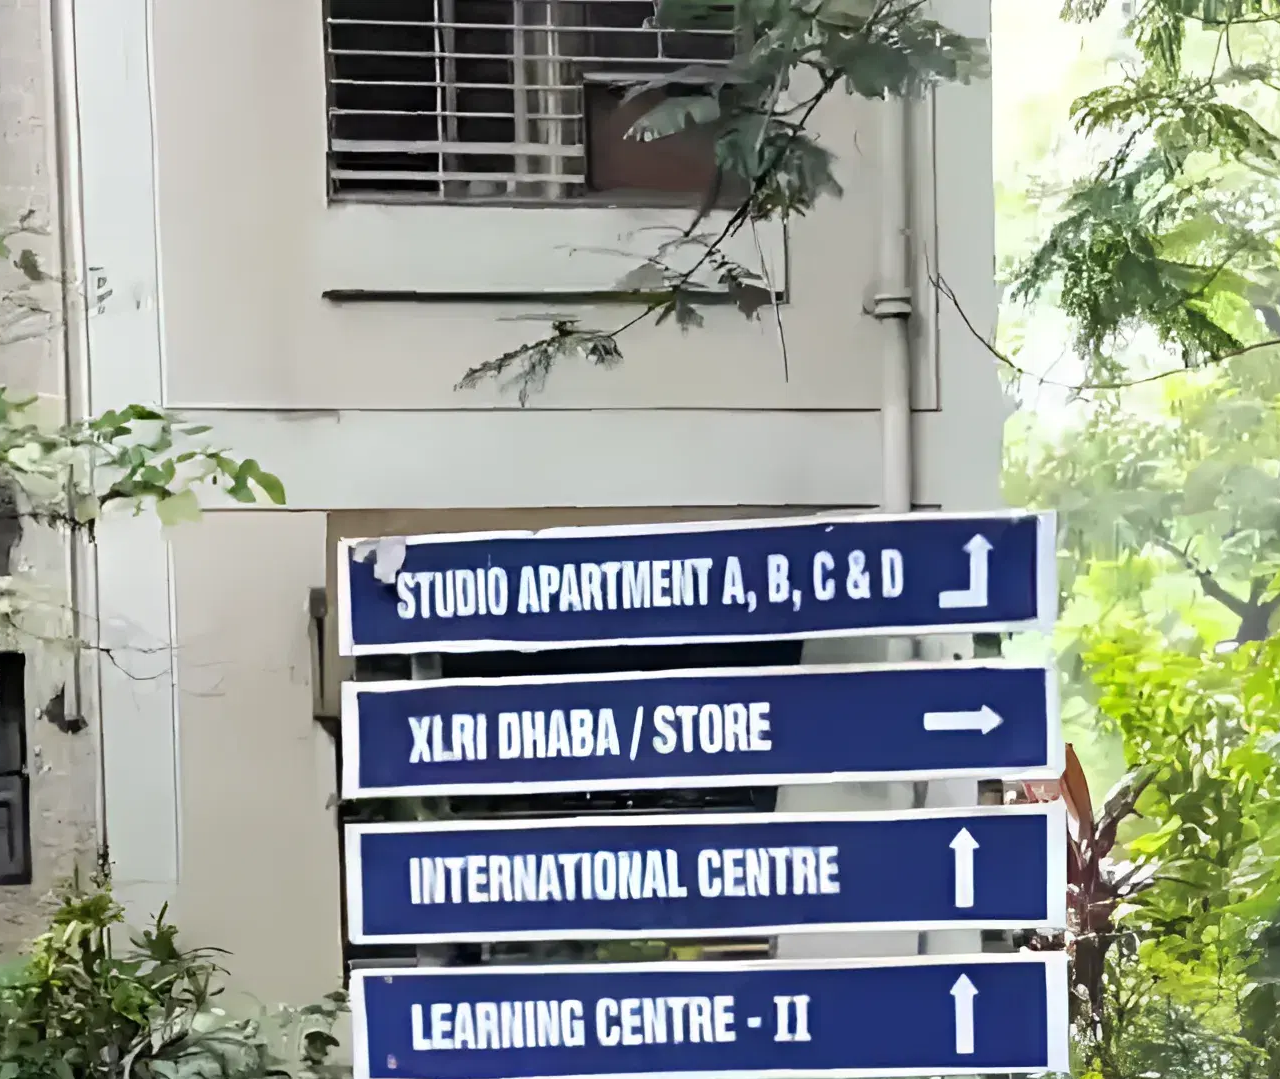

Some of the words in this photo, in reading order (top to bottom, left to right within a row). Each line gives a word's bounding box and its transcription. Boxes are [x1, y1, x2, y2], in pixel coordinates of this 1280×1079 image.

[396, 566, 509, 620] STUDIO
[517, 557, 713, 614] APARTMENT
[721, 555, 757, 613] A,
[767, 553, 802, 612] B,
[812, 550, 836, 601] C
[845, 549, 871, 600] &
[880, 548, 904, 598] D
[407, 712, 488, 764] XLRI
[498, 707, 621, 760] DHABA
[629, 705, 644, 761] /
[652, 701, 773, 755] STORE
[409, 848, 688, 905] INTERNATIONAL
[697, 845, 841, 898] CENTRE
[410, 999, 586, 1051] LEARNING
[595, 994, 737, 1047] CENTRE
[746, 1016, 762, 1029] -
[773, 994, 812, 1042] II
